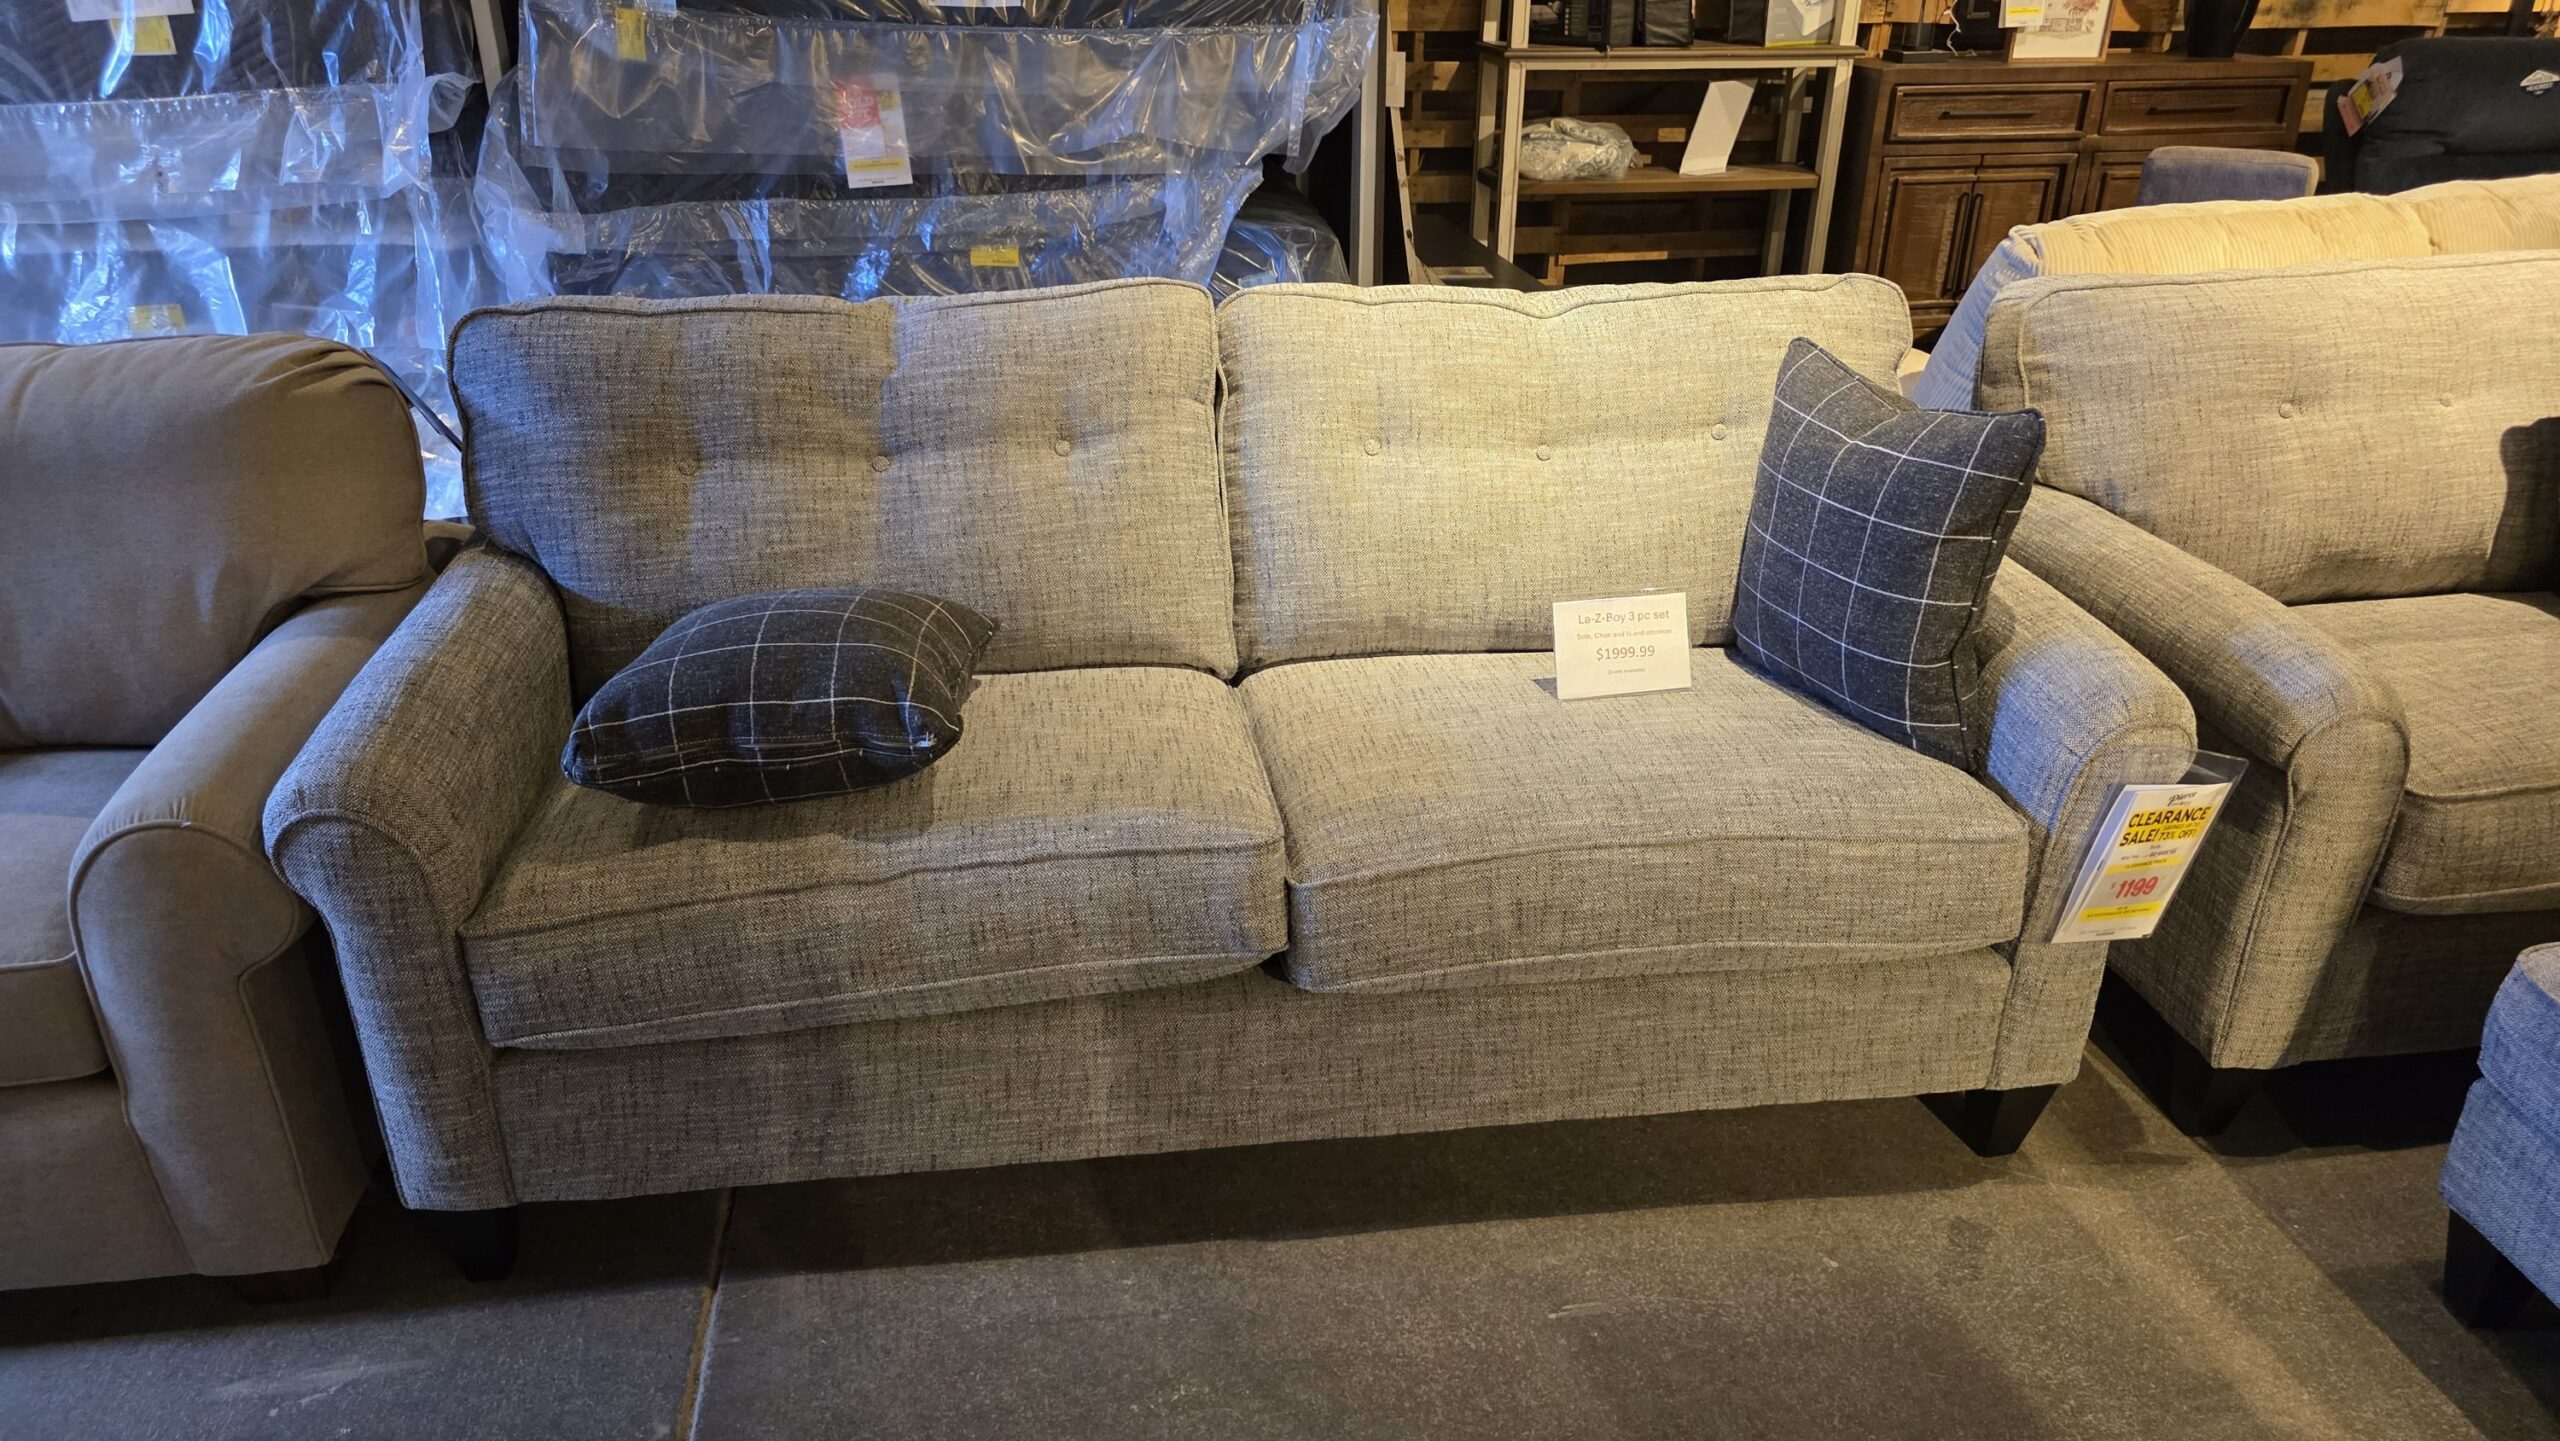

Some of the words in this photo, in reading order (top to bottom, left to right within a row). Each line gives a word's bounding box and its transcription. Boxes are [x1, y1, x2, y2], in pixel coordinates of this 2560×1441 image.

[1577, 612, 1626, 625] La-Z-Boy
[1628, 611, 1635, 621] 3
[1637, 612, 1650, 623] pc
[1653, 610, 1669, 620] set
[1596, 645, 1655, 662] $1999.99
[2128, 806, 2212, 829] CLEARANCE
[2119, 828, 2160, 847] SALE!
[2115, 876, 2160, 899] 1199
